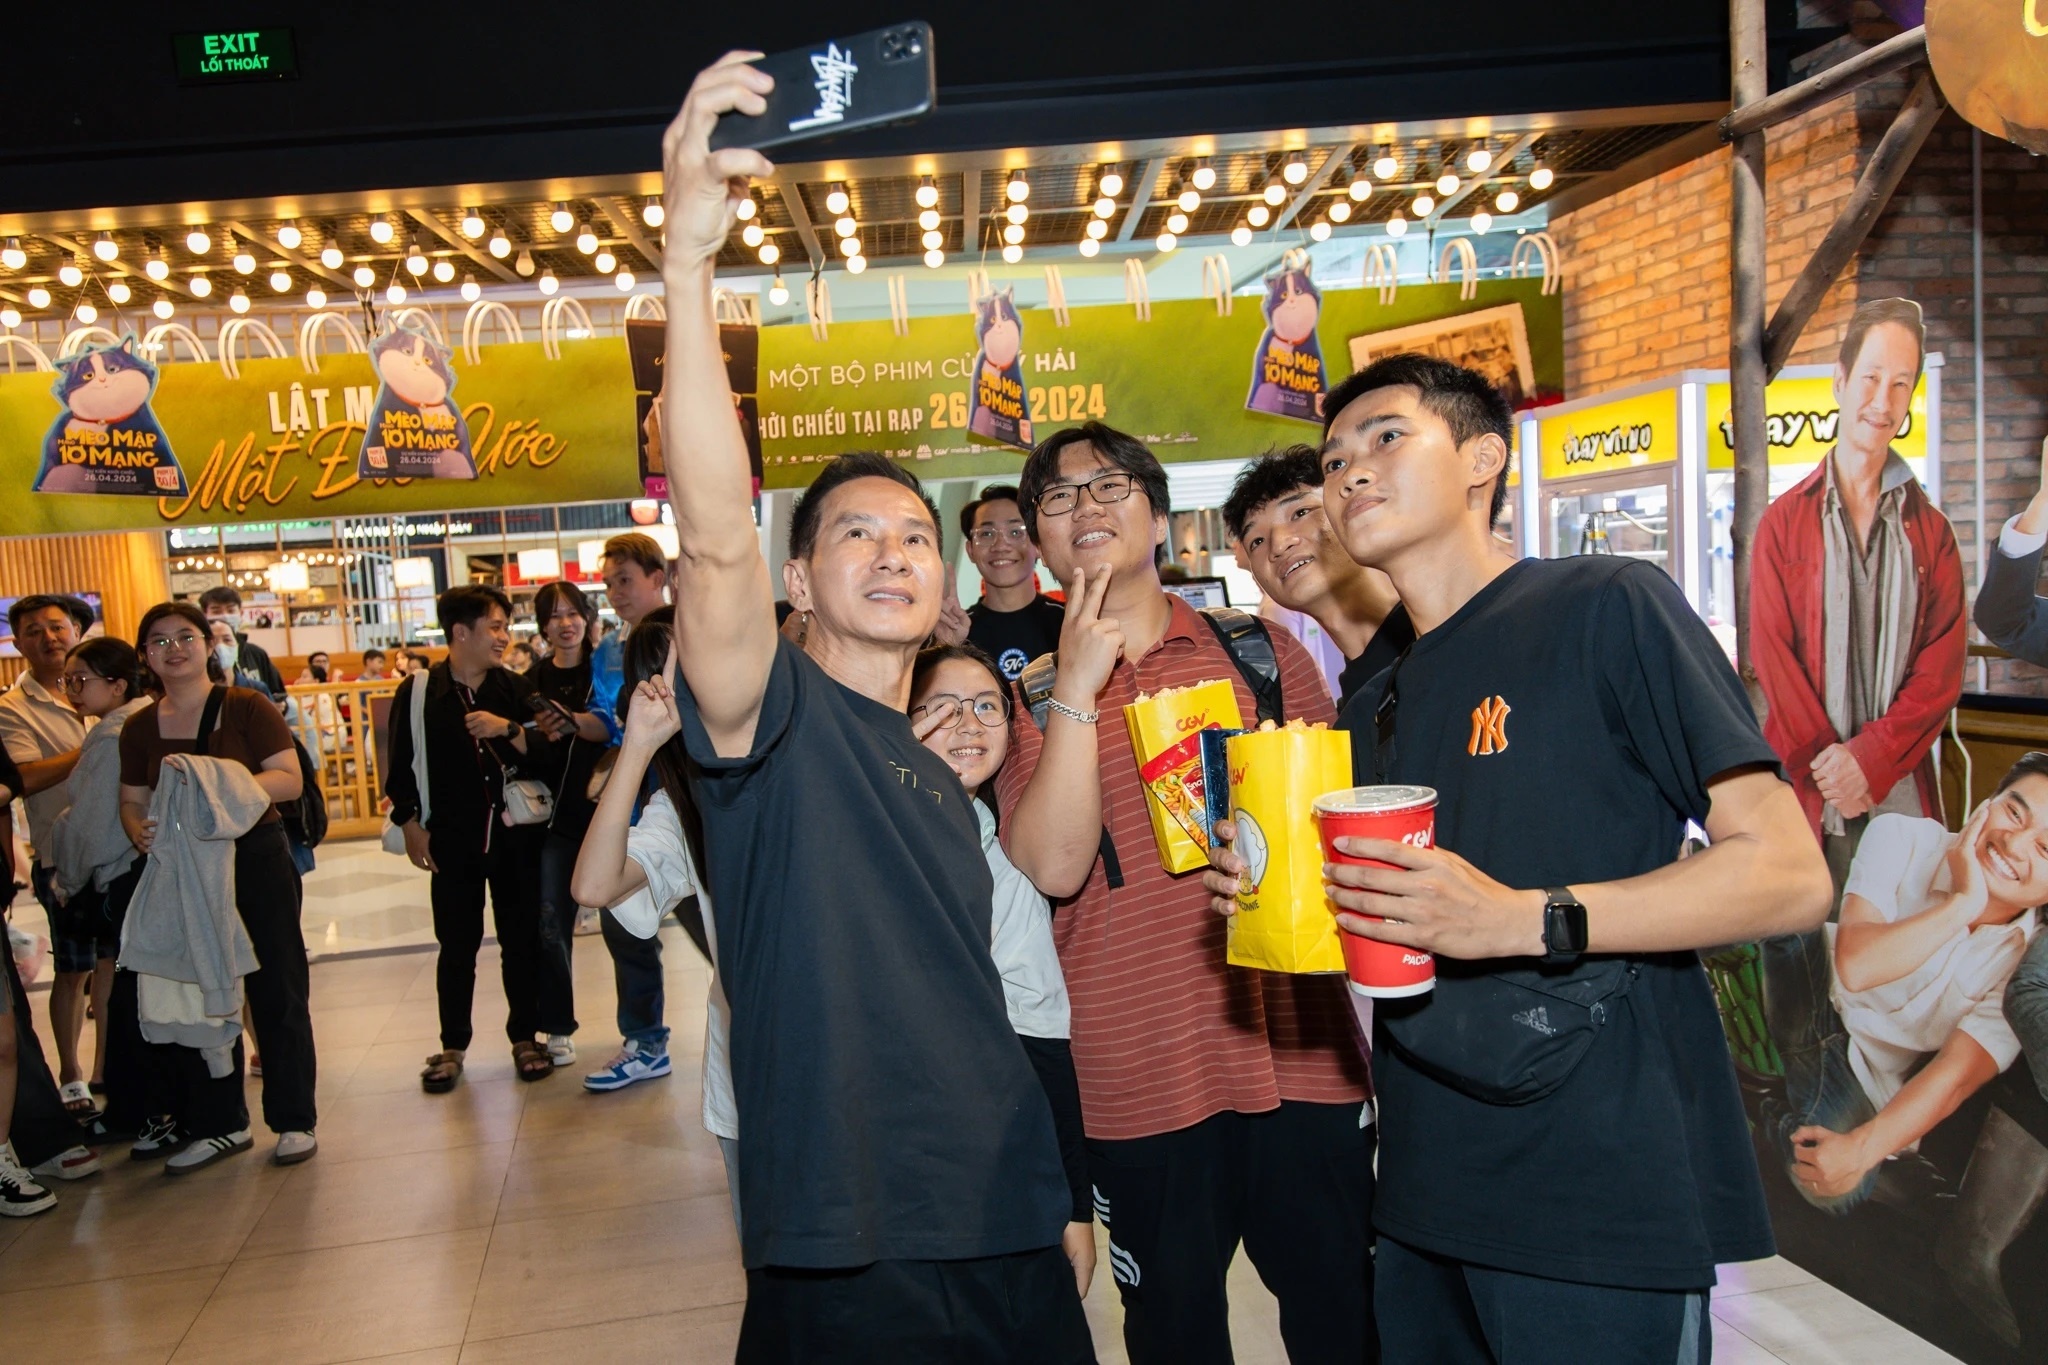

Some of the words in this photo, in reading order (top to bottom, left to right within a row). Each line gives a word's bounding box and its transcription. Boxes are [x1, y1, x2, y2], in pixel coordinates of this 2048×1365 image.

[204, 33, 260, 54] EXIT
[201, 55, 223, 73] LỐI
[225, 54, 269, 71] THOÁT
[769, 363, 822, 392] MỘT
[830, 360, 866, 388] BỘ
[874, 359, 933, 382] PHIM
[941, 352, 976, 379] CỦ
[1035, 347, 1076, 373] HẢI
[268, 382, 330, 438] LẬT
[758, 411, 787, 439] HỞI
[793, 406, 846, 438] CHIẾU
[852, 410, 882, 437] TẠI
[888, 408, 923, 435] RẠP
[113, 429, 157, 449] MẬP
[382, 428, 404, 449] 10
[1563, 433, 1601, 465] PLAY
[59, 445, 87, 465] 10
[89, 446, 159, 469] MẠNG
[84, 473, 137, 483] 26.04.2024
[158, 430, 300, 519] Một
[1176, 712, 1206, 732] CGV
[1467, 694, 1512, 757] NY
